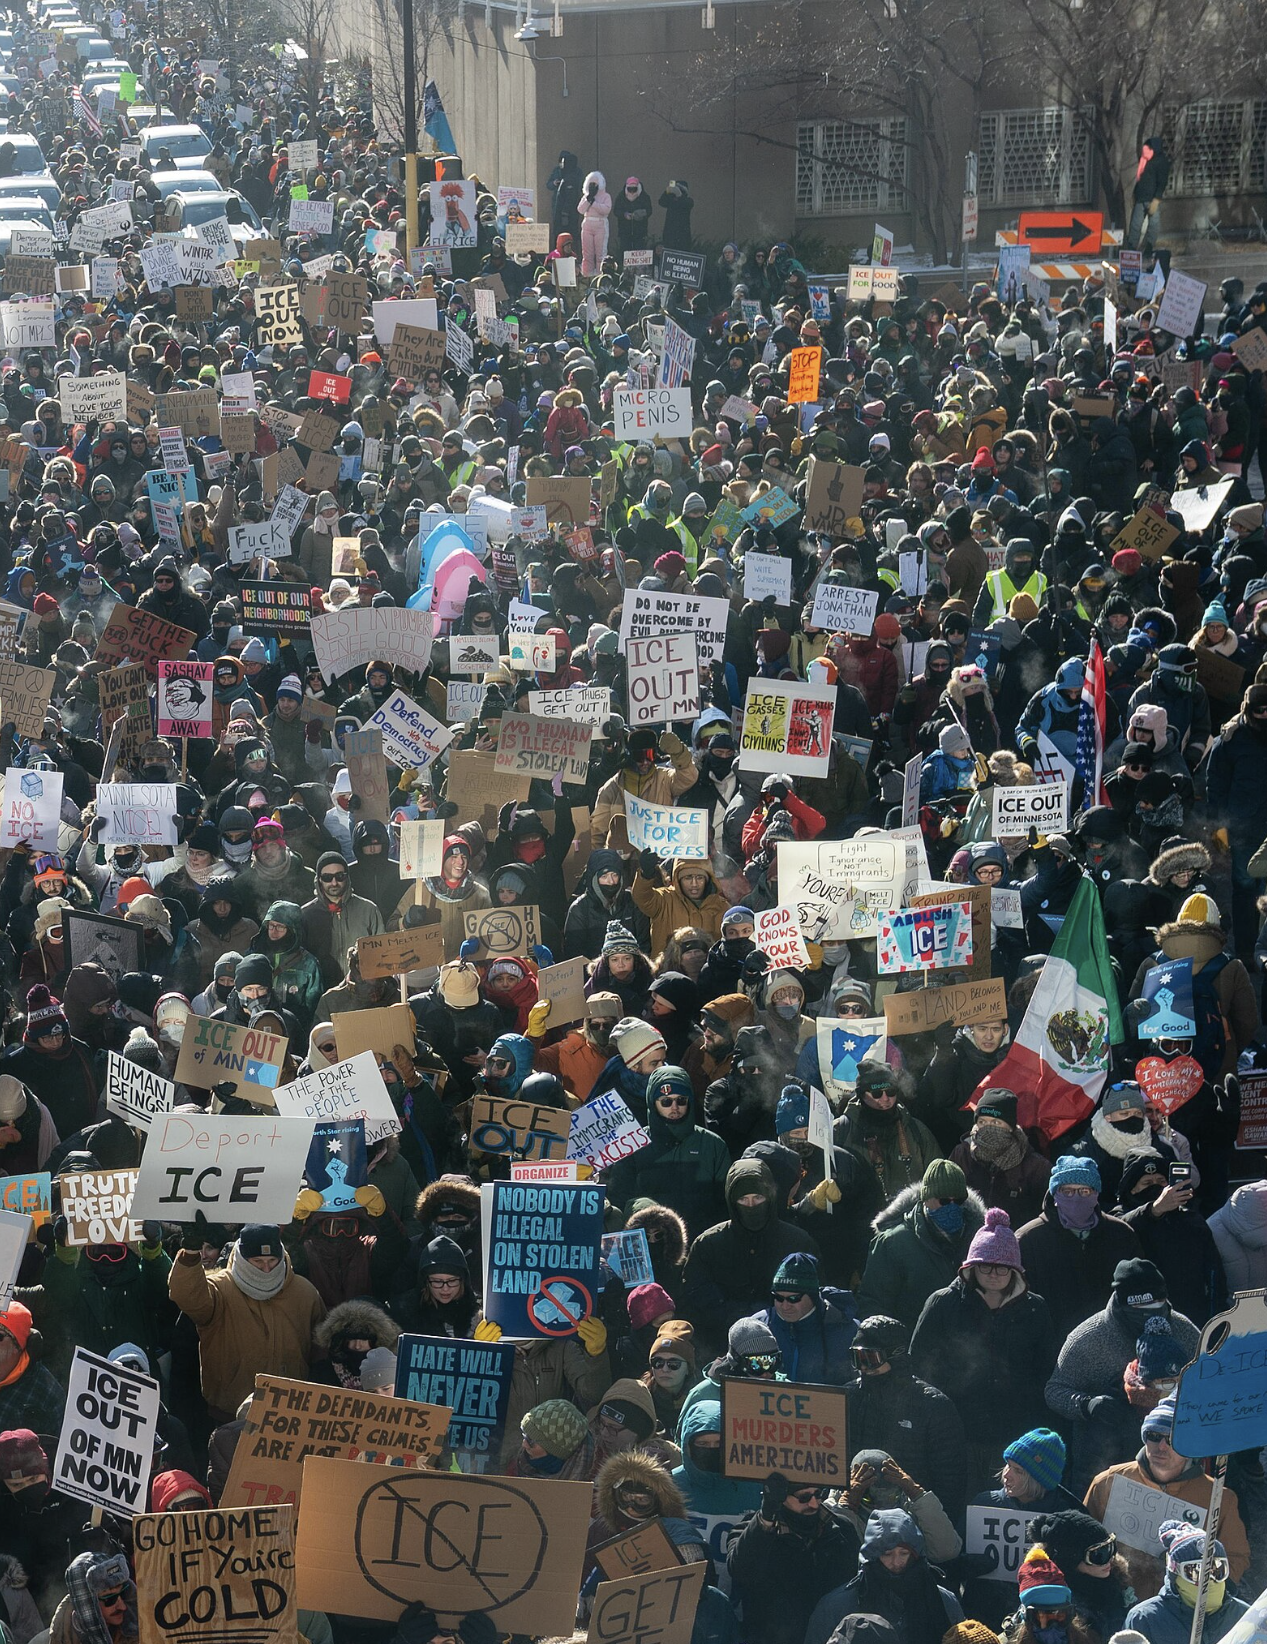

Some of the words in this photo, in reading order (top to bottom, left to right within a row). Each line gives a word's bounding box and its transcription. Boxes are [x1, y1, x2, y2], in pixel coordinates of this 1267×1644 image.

[182, 245, 214, 260] WINTER
[189, 261, 205, 269] KILLS
[260, 287, 298, 311] ICE
[261, 308, 300, 328] OUT
[262, 326, 302, 343] NOW
[620, 391, 670, 406] MICRO
[623, 405, 680, 429] PENIS
[242, 589, 256, 602] ICE
[259, 591, 276, 604] OUT
[278, 592, 289, 605] OF
[291, 592, 309, 606] OUR
[822, 586, 870, 600] ARREST
[243, 607, 310, 621] NEIGHBORHOODS
[816, 600, 872, 617] JONATHAN
[827, 615, 855, 630] ROSS
[630, 640, 682, 667] ICE
[164, 663, 207, 678] SASHAY
[631, 670, 694, 700] OUT
[639, 704, 661, 720] OF
[673, 699, 698, 714] MN
[169, 722, 201, 735] AWAY
[999, 798, 1026, 812] ICE
[1031, 794, 1063, 811] OUT
[1013, 811, 1063, 823] MINNESOTA
[893, 908, 952, 928] ABOLISH
[911, 925, 947, 957] ICE
[111, 1054, 167, 1099] HUMAN
[478, 1098, 558, 1135] ICE
[160, 1118, 282, 1162] Deport
[473, 1123, 567, 1160] OUT
[159, 1166, 265, 1203] ICE
[514, 1167, 569, 1180] ORGANIZE
[497, 1187, 576, 1214] NOBODY
[580, 1191, 599, 1214] IS
[496, 1217, 565, 1241] ILLEGAL
[494, 1247, 521, 1269] ON
[526, 1244, 593, 1270] STOLEN
[493, 1270, 541, 1294] LAND
[87, 1370, 142, 1411] ICE
[77, 1394, 147, 1439] OUT
[759, 1392, 811, 1418] ICE
[732, 1418, 835, 1448] MURDERS
[70, 1429, 99, 1455] OF
[103, 1443, 143, 1479] MN
[729, 1444, 838, 1475] AMERICANS
[61, 1454, 141, 1499] NOW
